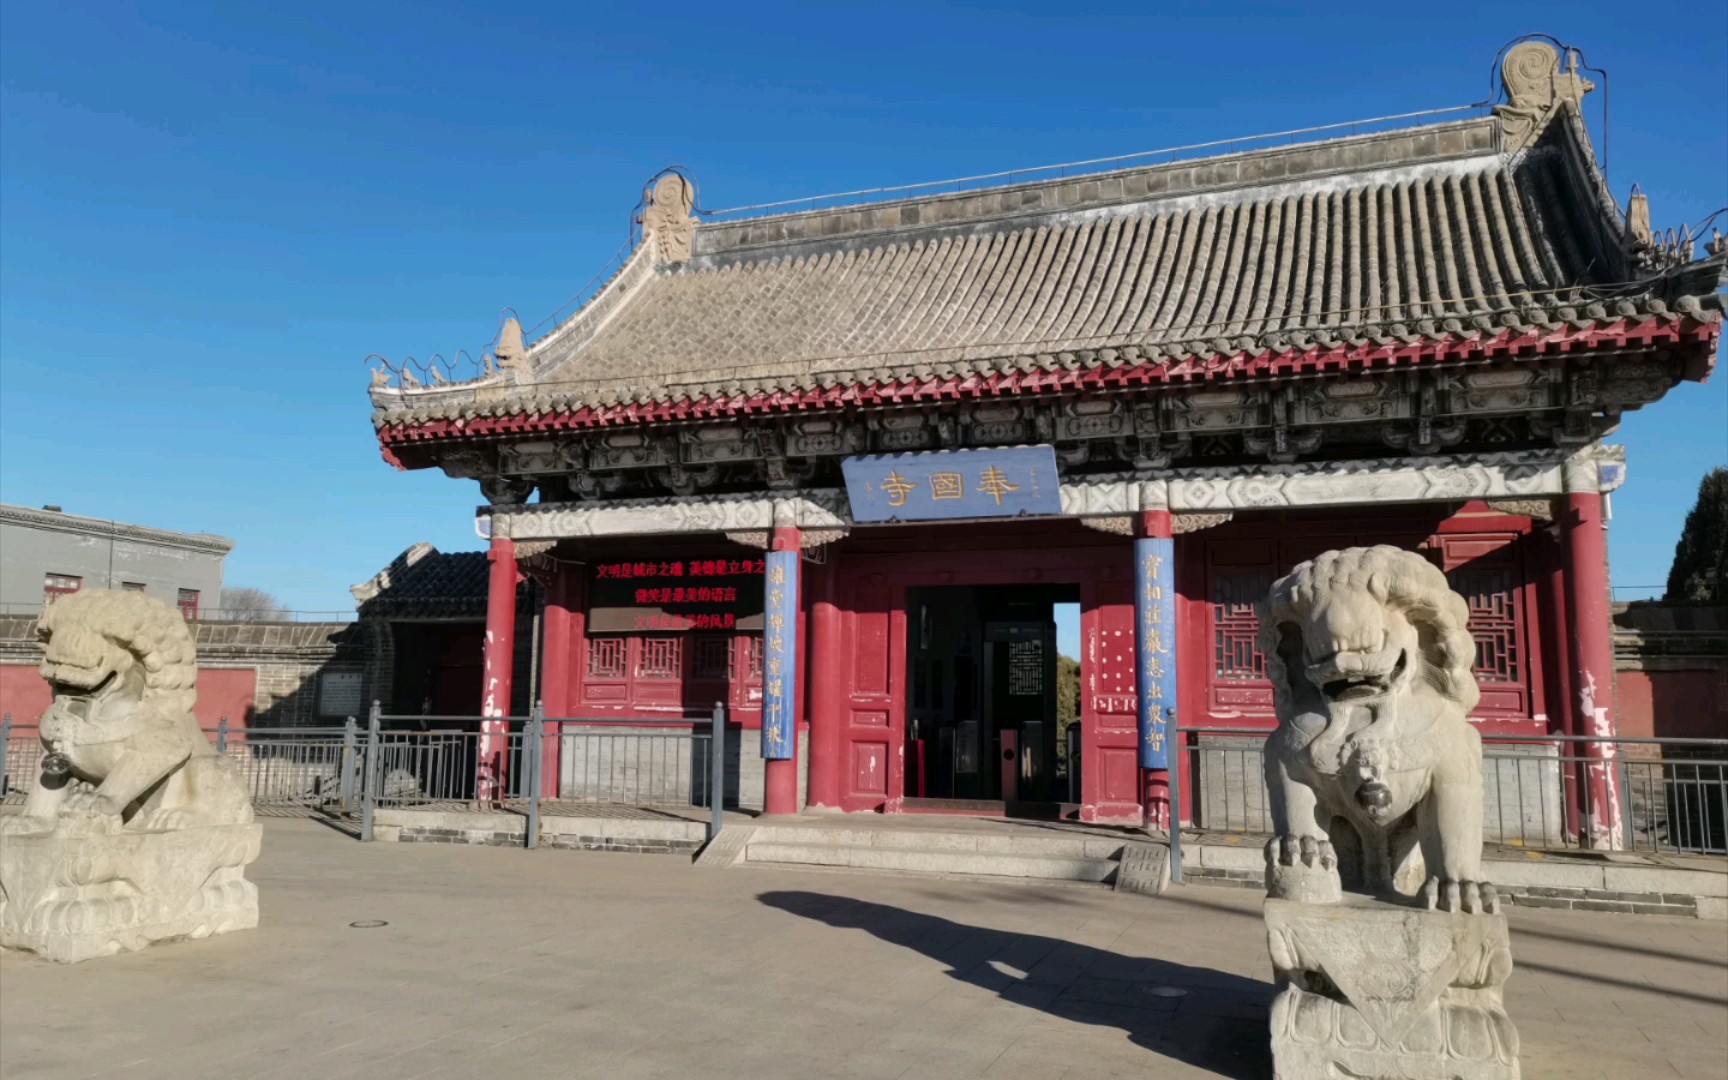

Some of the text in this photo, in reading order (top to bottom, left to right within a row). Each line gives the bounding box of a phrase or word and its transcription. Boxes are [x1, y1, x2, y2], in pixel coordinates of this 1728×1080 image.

[880, 464, 1021, 507] 奉國寺
[635, 587, 737, 604] 微笑是最美的语言
